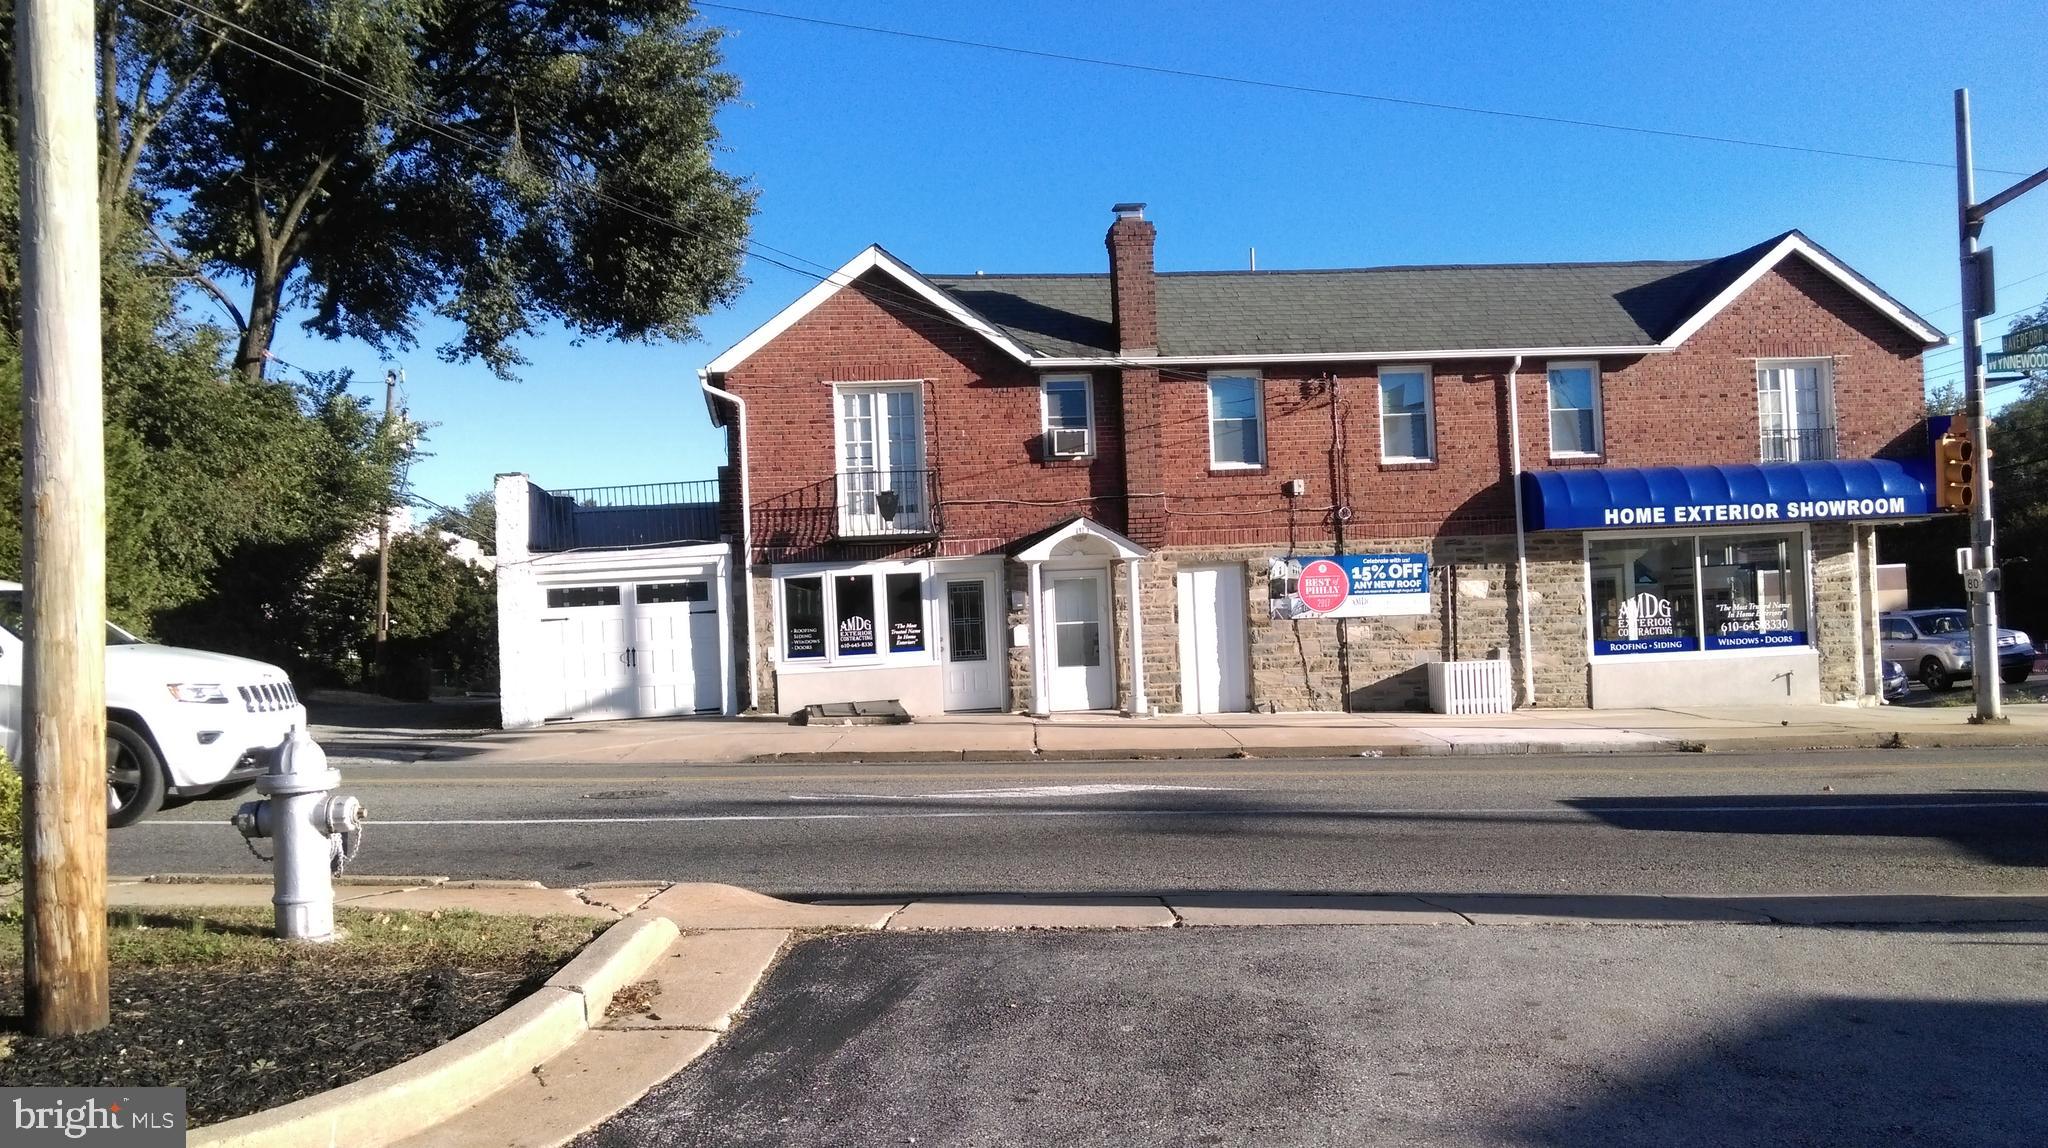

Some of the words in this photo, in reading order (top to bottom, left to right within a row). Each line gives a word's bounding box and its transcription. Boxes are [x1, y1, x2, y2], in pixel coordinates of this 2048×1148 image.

[2003, 328, 2044, 353] HAVERFORD
[1604, 506, 1666, 525] HOME
[1674, 503, 1779, 523] EXTERIOR
[1787, 497, 1905, 518] SHOWROOM
[1351, 565, 1387, 581] 15%
[1388, 563, 1423, 579] OFF
[1305, 578, 1331, 587] BEST
[1353, 581, 1372, 590] ANY
[1374, 580, 1395, 589] NEW
[1397, 579, 1422, 588] ROOF
[1968, 578, 1979, 589] 80
[1305, 586, 1340, 595] PHILLY
[1618, 592, 1672, 619] AMDG
[840, 615, 872, 631] AMDG
[1610, 643, 1648, 651] ROOFING
[1653, 641, 1683, 649] SIDING
[1717, 637, 1760, 646] WINDOWS
[1765, 635, 1793, 644] DOORS
